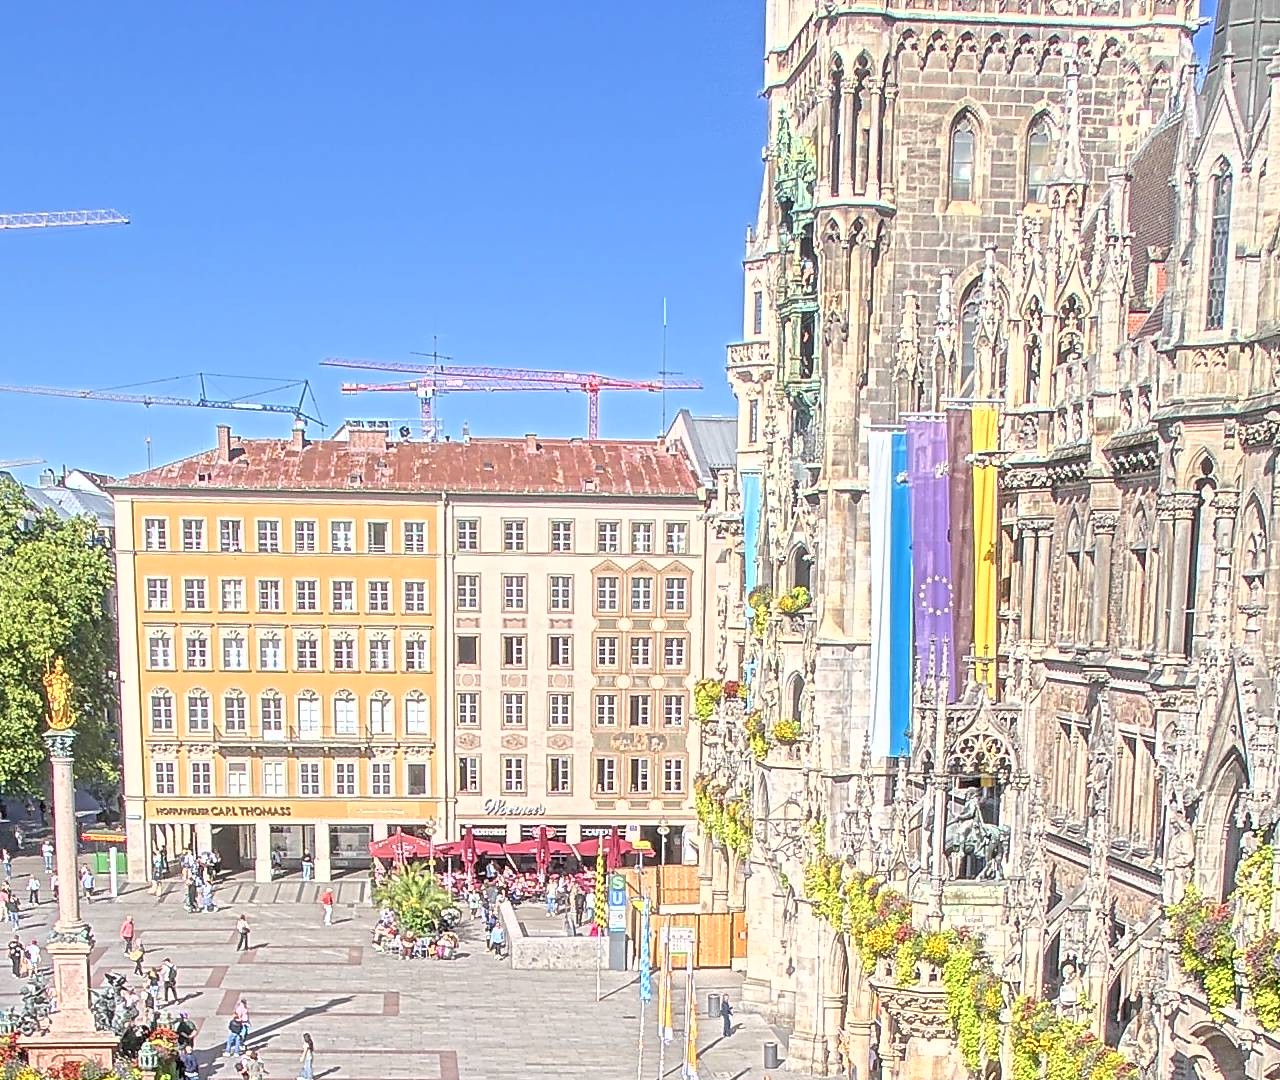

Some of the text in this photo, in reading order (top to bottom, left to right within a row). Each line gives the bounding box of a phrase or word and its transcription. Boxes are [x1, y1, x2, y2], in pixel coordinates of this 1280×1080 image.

[210, 806, 238, 817] CARL
[239, 806, 292, 817] THOMASS
[612, 876, 625, 890] S
[612, 890, 623, 905] U
